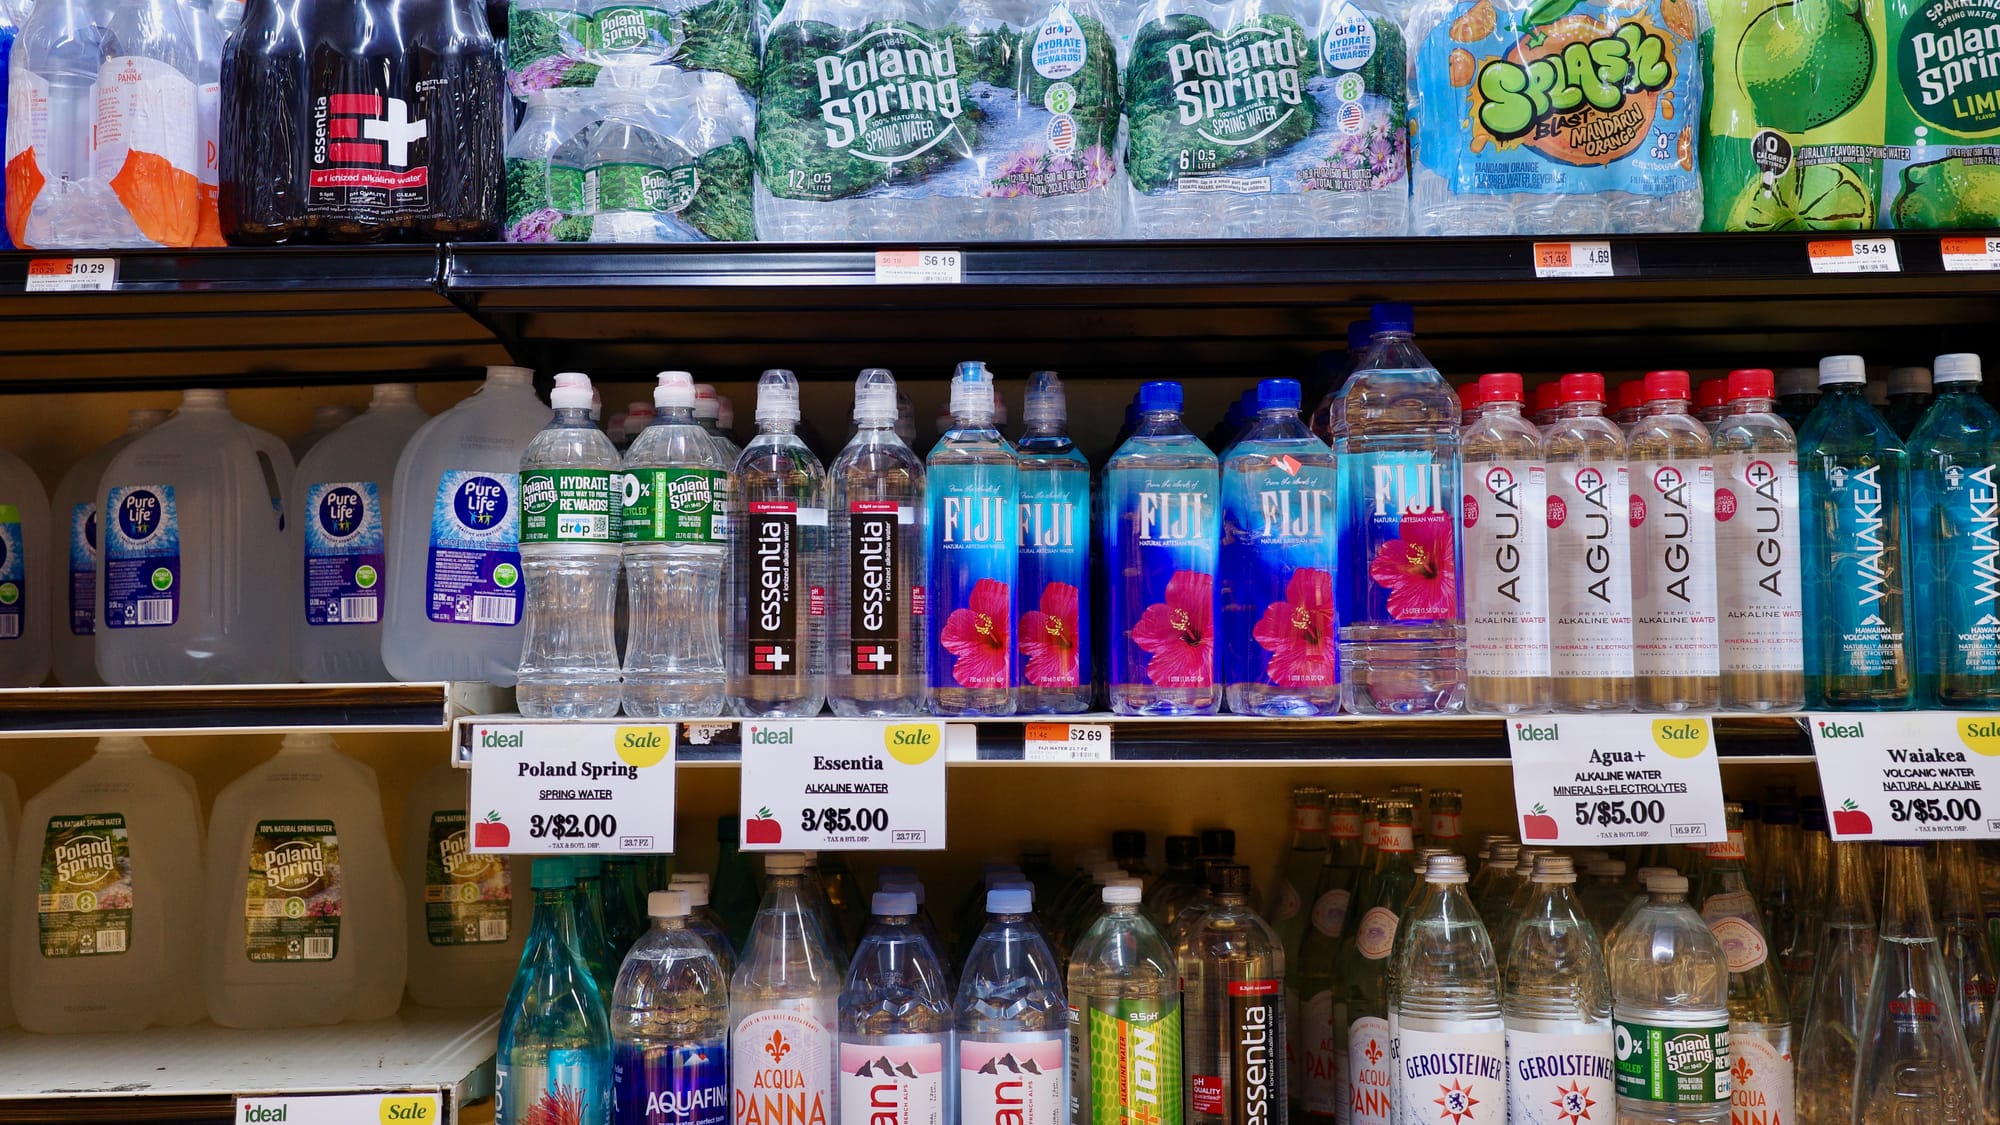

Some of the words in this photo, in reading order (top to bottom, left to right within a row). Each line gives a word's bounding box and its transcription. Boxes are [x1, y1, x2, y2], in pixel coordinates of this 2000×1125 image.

[601, 11, 645, 34] Poland
[1938, 10, 1966, 28] SPRING
[1967, 10, 1997, 20] WATER
[602, 25, 647, 49] Spring
[1038, 38, 1081, 50] HYDRATE
[1330, 36, 1370, 49] HYDRATE
[1166, 27, 1298, 85] Poland
[1330, 50, 1370, 62] REWARDS!
[1912, 24, 2000, 72] Polan
[814, 36, 958, 101] Poland
[1037, 56, 1081, 66] REWARDS!
[118, 74, 142, 82] PANNA
[1918, 50, 2000, 106] Sprin
[415, 82, 422, 93] 6
[1174, 68, 1302, 125] Spring
[820, 77, 963, 148] Spring
[1238, 102, 1266, 114] NATURAL
[1952, 90, 2000, 118] LIM
[872, 117, 889, 128] 100%
[891, 113, 923, 121] NATURAL
[1212, 114, 1247, 136] SPRING
[1247, 106, 1278, 128] WATER
[1534, 108, 1592, 140] BLAST
[1975, 112, 1996, 120] FLAVOR
[314, 97, 327, 164] essentia
[1570, 103, 1643, 148] MANDARIN
[866, 124, 900, 151] SPRING
[902, 120, 935, 144] WATER
[1586, 128, 1635, 156] ORANGE
[1765, 136, 1778, 152] 0
[1180, 150, 1189, 170] 6
[1198, 150, 1216, 160] 0.5
[1756, 152, 1787, 165] CALORIES
[1830, 146, 1864, 158] FLAVORED
[1865, 147, 1887, 158] SPRING
[1888, 148, 1910, 160] WATER
[1476, 163, 1510, 173] MANDARIN
[1512, 163, 1539, 172] ORANGE
[329, 174, 359, 182] ionized
[361, 174, 396, 184] alkaline
[788, 169, 805, 190] 12
[814, 173, 832, 182] 0.5
[1506, 174, 1530, 184] WATER
[1543, 256, 1567, 264] $1.48
[1589, 251, 1610, 264] 4.69
[66, 264, 104, 274] $10.29
[465, 482, 500, 497] Pure
[523, 476, 554, 495] Poland
[560, 476, 608, 490] HYDRATE
[668, 477, 710, 494] Poland
[1372, 464, 1443, 516] FIJI
[126, 496, 156, 510] Pure
[327, 493, 358, 507] Pure
[468, 496, 496, 514] Life
[524, 490, 556, 511] Spring
[560, 499, 608, 512] REWARDS!
[670, 490, 711, 510] Spring
[130, 508, 151, 524] Life
[330, 506, 354, 521] Life
[944, 497, 1004, 542] FIJI
[1140, 492, 1203, 540] FIJI
[1260, 490, 1324, 536] FIJI
[1019, 503, 1072, 546] FIJI
[1854, 464, 1886, 606] WAIAKEA
[1969, 464, 2000, 606] WAIAKEA
[758, 522, 780, 631] essentia
[860, 522, 882, 631] essentia
[480, 729, 523, 748] ideal
[750, 726, 792, 744] ideal
[894, 730, 931, 745] Sale
[1516, 723, 1558, 741] ideal
[1662, 724, 1699, 740] Sale
[1819, 722, 1864, 738] ideal
[624, 732, 661, 748] Sale
[814, 755, 884, 770] Essentia
[1589, 748, 1646, 766] Agua+
[1886, 748, 1966, 763] Waiakea
[518, 762, 577, 777] Poland
[582, 762, 638, 780] Spring
[1575, 772, 1624, 782] ALKALINE
[1626, 770, 1662, 780] WATER
[1883, 768, 1936, 778] VOLCANIC
[1938, 768, 1974, 777] WATER
[540, 790, 576, 800] SPRING
[578, 790, 612, 800] WATER
[806, 784, 852, 793] ALKALINE
[854, 784, 888, 793] WATER
[1554, 783, 1687, 796] MINERALS+ELECTROLYTES
[1883, 782, 1930, 791] NATURAL
[1933, 781, 1981, 790] ALKALINE
[1576, 800, 1665, 828] 5/$5.00
[1890, 798, 1981, 824] 3/$5.00
[530, 814, 616, 840] 3/$2.00
[801, 808, 888, 834] 3/$5.00
[55, 836, 112, 864] Poland
[264, 842, 322, 870] Poland
[57, 853, 114, 882] Spring
[266, 860, 324, 887] Spring
[1664, 1034, 1711, 1057] Poland
[1406, 1053, 1501, 1082] GEROLSTEINER
[1518, 1054, 1614, 1082] GEROLSTEINER
[1666, 1049, 1712, 1071] Spring
[754, 1069, 804, 1089] ACQUA
[1194, 1079, 1204, 1087] pH
[1194, 1087, 1221, 1095] QUALITY
[1731, 1090, 1766, 1106] CQUA
[245, 1104, 287, 1122] ideal
[388, 1103, 426, 1120] Sale
[736, 1089, 826, 1125] PANNA
